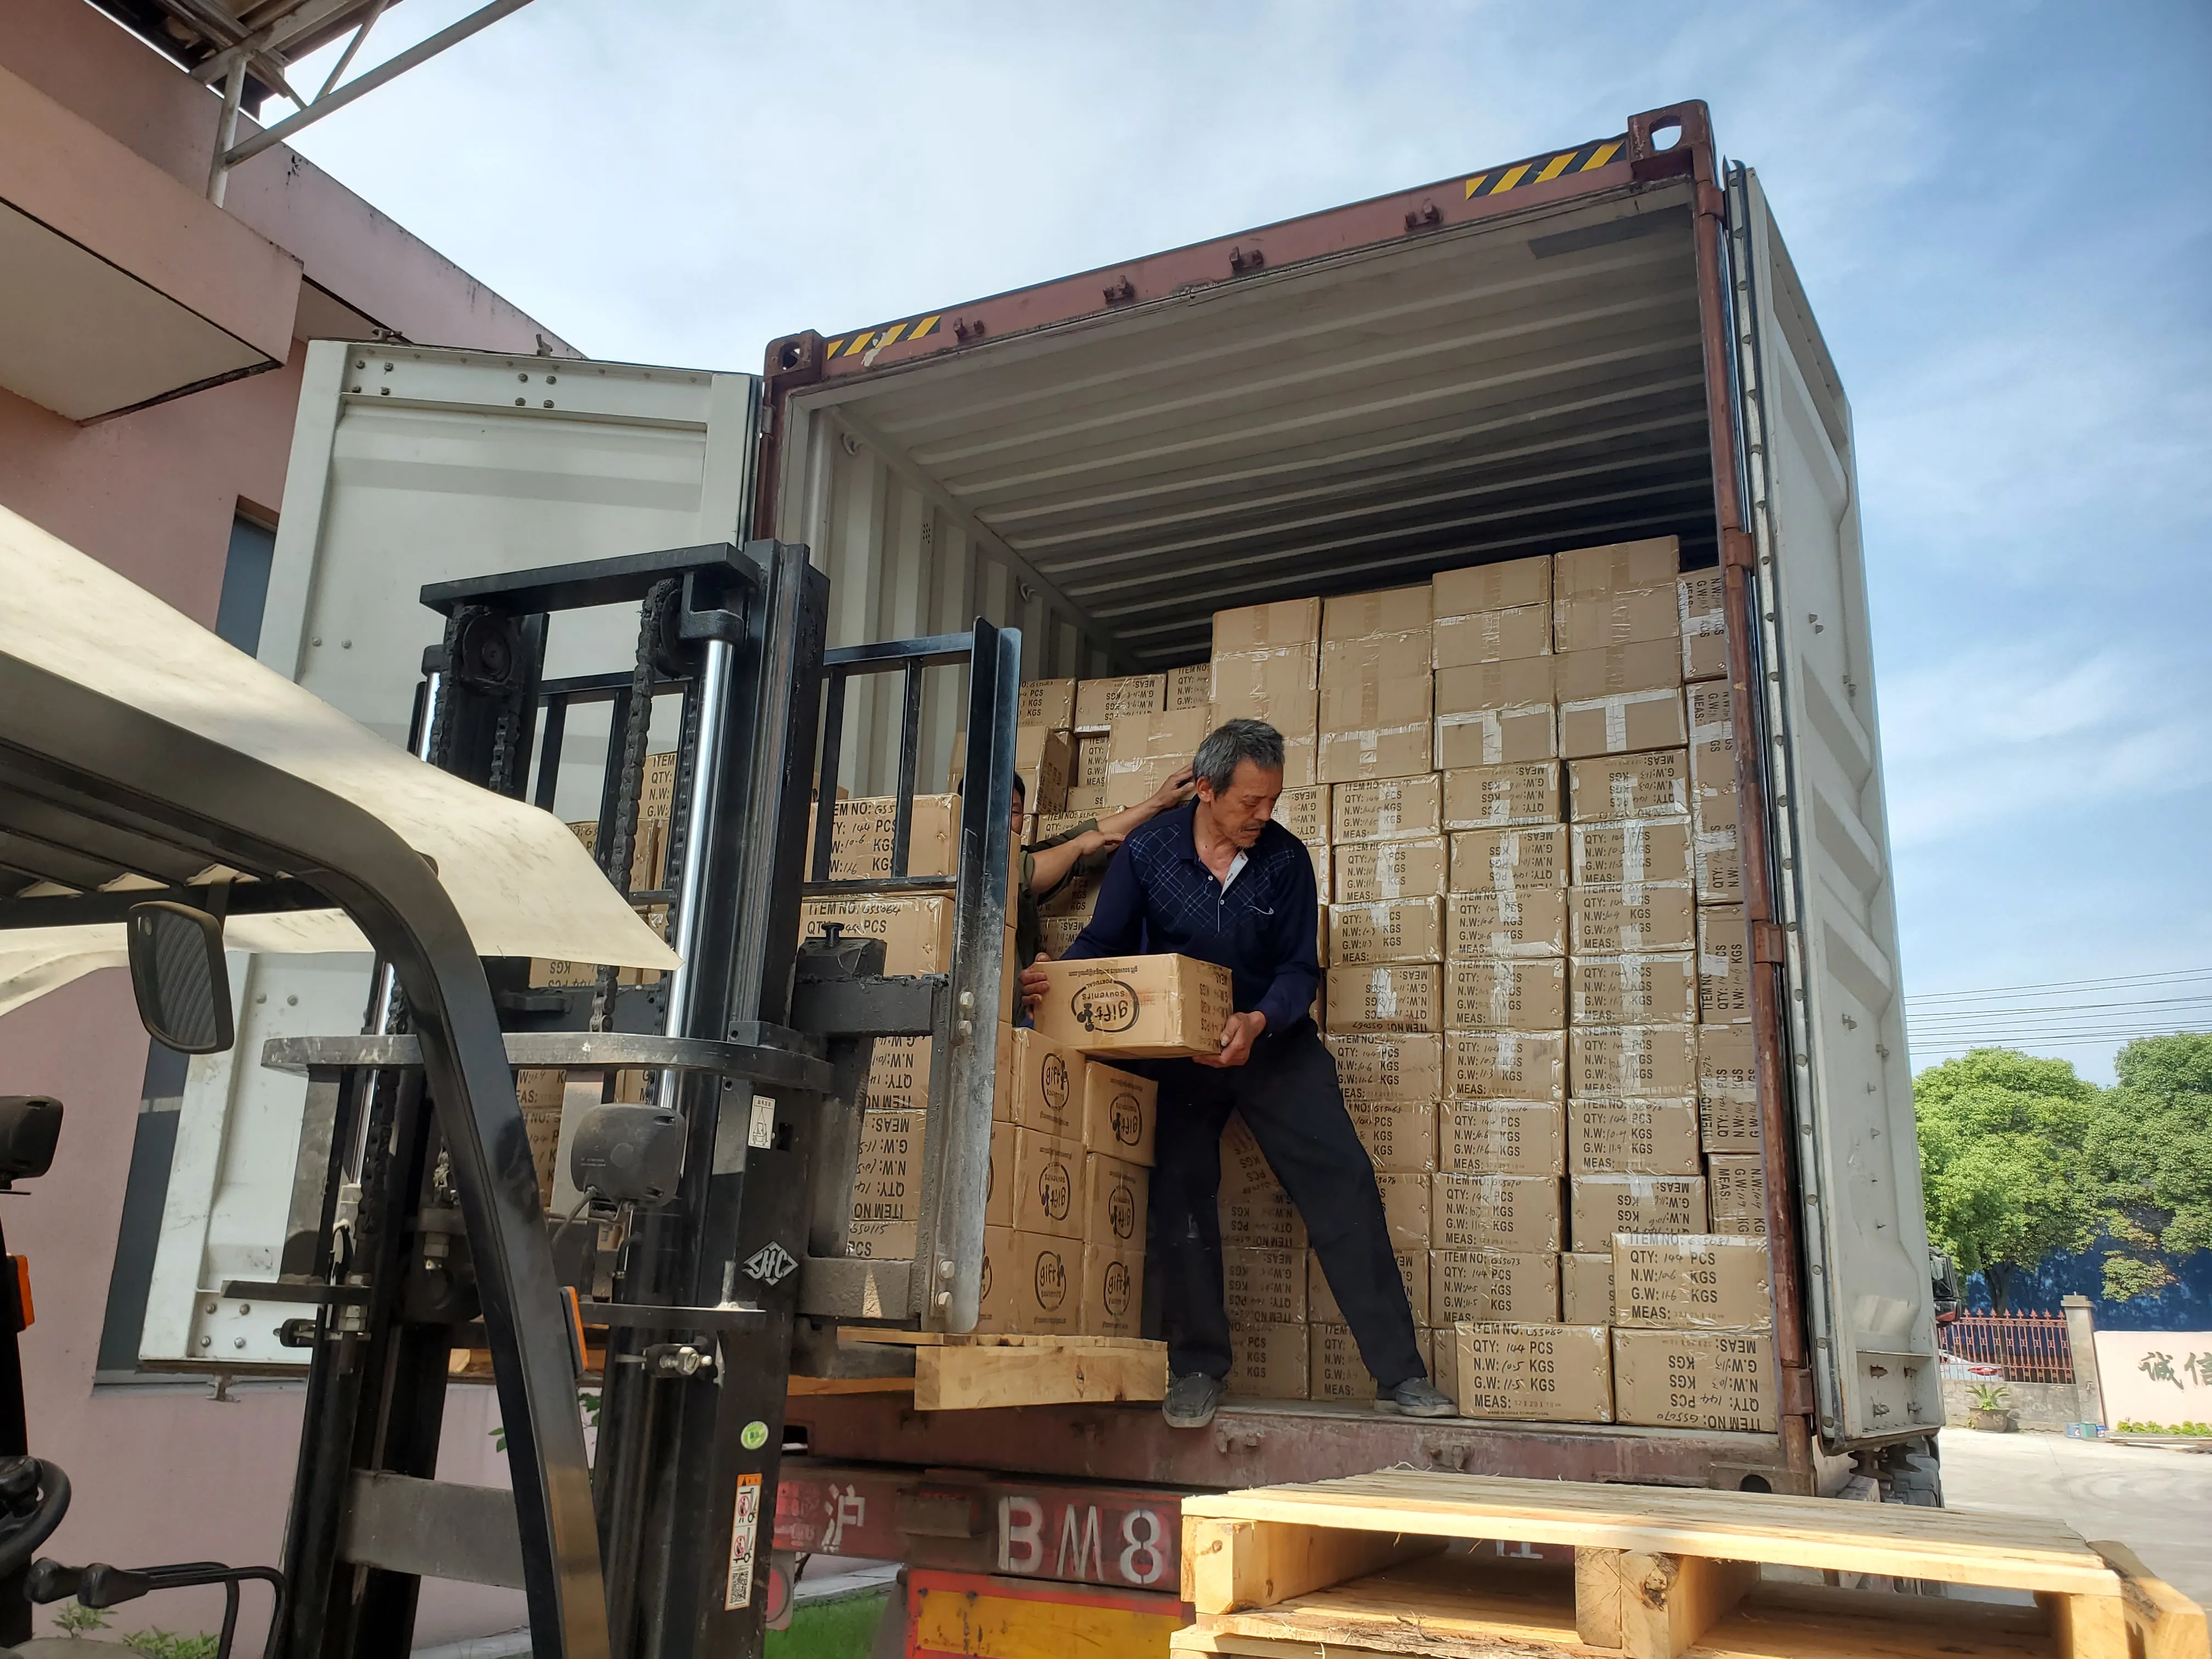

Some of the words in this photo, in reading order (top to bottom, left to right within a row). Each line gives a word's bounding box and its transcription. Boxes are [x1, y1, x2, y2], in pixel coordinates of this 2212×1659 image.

[653, 754, 675, 767] ITEM
[651, 771, 672, 783] QTY:
[1345, 794, 1363, 803] QTY:
[851, 803, 871, 815] NO:
[1384, 803, 1401, 811] KGS
[1523, 803, 1544, 812] QTY:
[1585, 834, 1606, 844] QTY:
[1348, 855, 1367, 864] QTY:
[1531, 870, 1552, 879] QTY:
[1347, 891, 1373, 900] MEAS:
[809, 902, 836, 915] ITEM
[1584, 898, 1605, 907] QTY:
[1460, 905, 1481, 914] QTY:
[1630, 909, 1651, 919] KGS
[1342, 915, 1361, 924] QTY:
[864, 920, 887, 933] PCS
[1383, 938, 1401, 946] KGS
[1584, 939, 1615, 948] MEAS:
[1342, 953, 1369, 962] MEAS:
[1458, 973, 1479, 983] QTY:
[1584, 968, 1605, 977] QTY:
[1086, 979, 1113, 988] PORTUGAL
[1082, 990, 1125, 1000] Souvenirs
[1094, 1000, 1128, 1022] gift
[1457, 1013, 1485, 1023] MEAS:
[1387, 1023, 1404, 1032] NO:
[1459, 1042, 1479, 1052] QTY:
[1584, 1041, 1607, 1051] QTY:
[1338, 1048, 1357, 1057] QTY:
[885, 1074, 912, 1088] QTY:
[1046, 1066, 1060, 1086] gift
[1502, 1071, 1522, 1081] KGS
[1457, 1084, 1486, 1094] MEAS:
[883, 1095, 911, 1108] ITEM
[872, 1118, 909, 1132] MEAS:
[1375, 1117, 1392, 1126] PCS
[1455, 1116, 1475, 1125] QTY:
[1584, 1114, 1606, 1124] QTY:
[1610, 1115, 1627, 1124] 144
[1121, 1116, 1138, 1135] gift
[1374, 1131, 1392, 1141] KGS
[1632, 1128, 1652, 1139] KGS
[1374, 1145, 1392, 1155] KGS
[1454, 1159, 1483, 1169] MEAS:
[1583, 1158, 1615, 1168] MEAS:
[878, 1182, 904, 1197] QTY:
[1447, 1189, 1468, 1200] QTY:
[1050, 1187, 1066, 1208] gift
[875, 1204, 903, 1218] ITEM
[1618, 1211, 1639, 1222] KGS
[1118, 1208, 1131, 1227] gift
[1446, 1233, 1476, 1245] MEAS:
[1444, 1251, 1467, 1262] ITEM
[1470, 1252, 1487, 1263] NO:
[1630, 1250, 1658, 1264] QTY:
[1664, 1254, 1683, 1263] 144
[1691, 1252, 1716, 1265] PCS
[1040, 1263, 1056, 1287] gift
[1444, 1267, 1466, 1278] QTY:
[1492, 1268, 1511, 1280] PCS
[1691, 1271, 1717, 1284] KGS
[1108, 1275, 1124, 1294] gift
[1491, 1284, 1511, 1296] KGS
[1691, 1289, 1718, 1303] KGS
[1491, 1300, 1512, 1311] KGS
[1632, 1305, 1671, 1320] MEAS:
[1472, 1323, 1500, 1335] ITEM
[1248, 1337, 1266, 1347] PCS
[1474, 1339, 1499, 1353] QTY:
[1506, 1343, 1525, 1354] 144
[1530, 1341, 1554, 1355] PCS
[1716, 1339, 1756, 1354] MEAS:
[1247, 1352, 1266, 1363] KGS
[1668, 1355, 1695, 1370] KGS
[1530, 1360, 1554, 1373] KGS
[1531, 1378, 1555, 1392] KGS
[1669, 1374, 1695, 1390] KGS
[1475, 1394, 1511, 1409] MEAS:
[1671, 1393, 1695, 1408] PCS
[1701, 1393, 1722, 1406] 144
[1730, 1397, 1759, 1412] QTY:
[1703, 1415, 1726, 1429] NO:
[1729, 1417, 1760, 1431] ITEM
[821, 1483, 865, 1554] 沪
